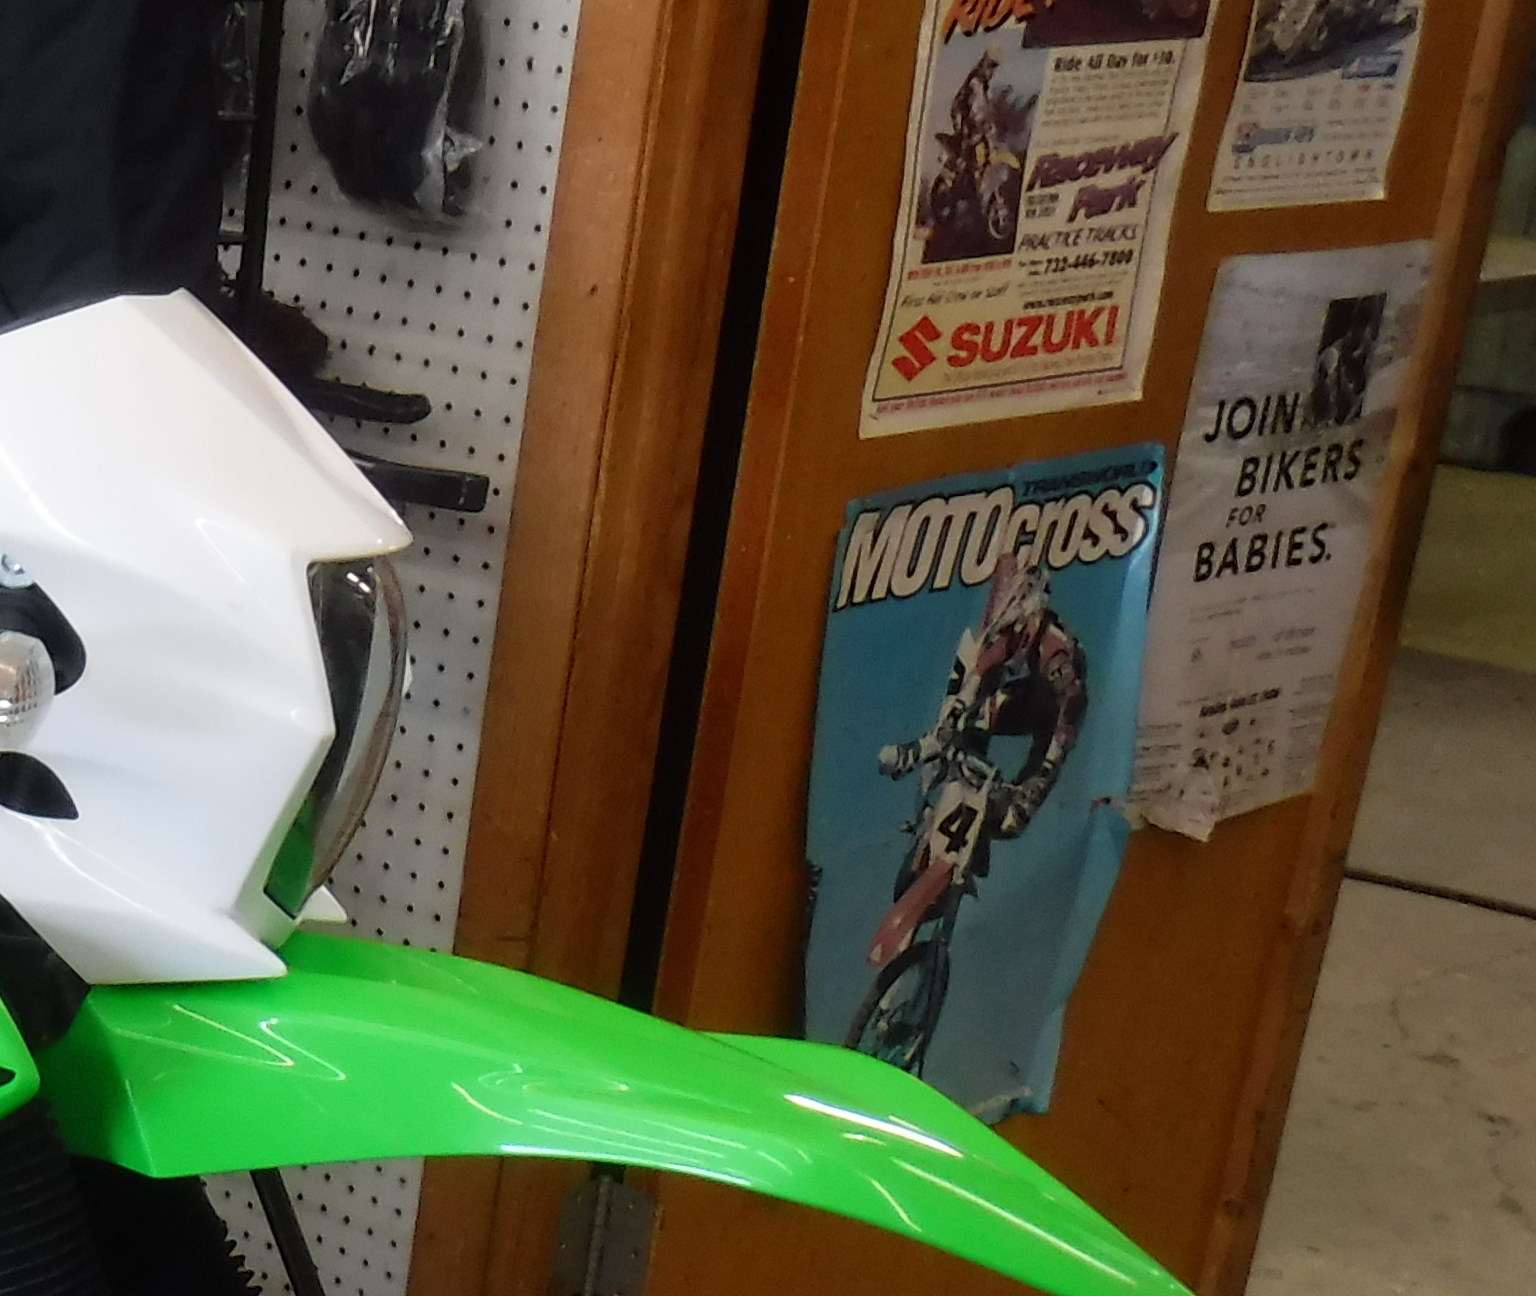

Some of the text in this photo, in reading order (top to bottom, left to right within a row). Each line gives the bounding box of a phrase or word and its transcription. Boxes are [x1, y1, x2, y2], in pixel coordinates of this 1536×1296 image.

[1026, 132, 1180, 192] Raceway
[1067, 176, 1147, 224] Park
[946, 304, 1121, 368] SUZUKI
[1203, 392, 1301, 442] JOIN
[1235, 438, 1365, 498] BIKERS
[1226, 503, 1267, 528] FOR
[1192, 522, 1334, 583] BABIES.
[938, 801, 979, 853] 4
